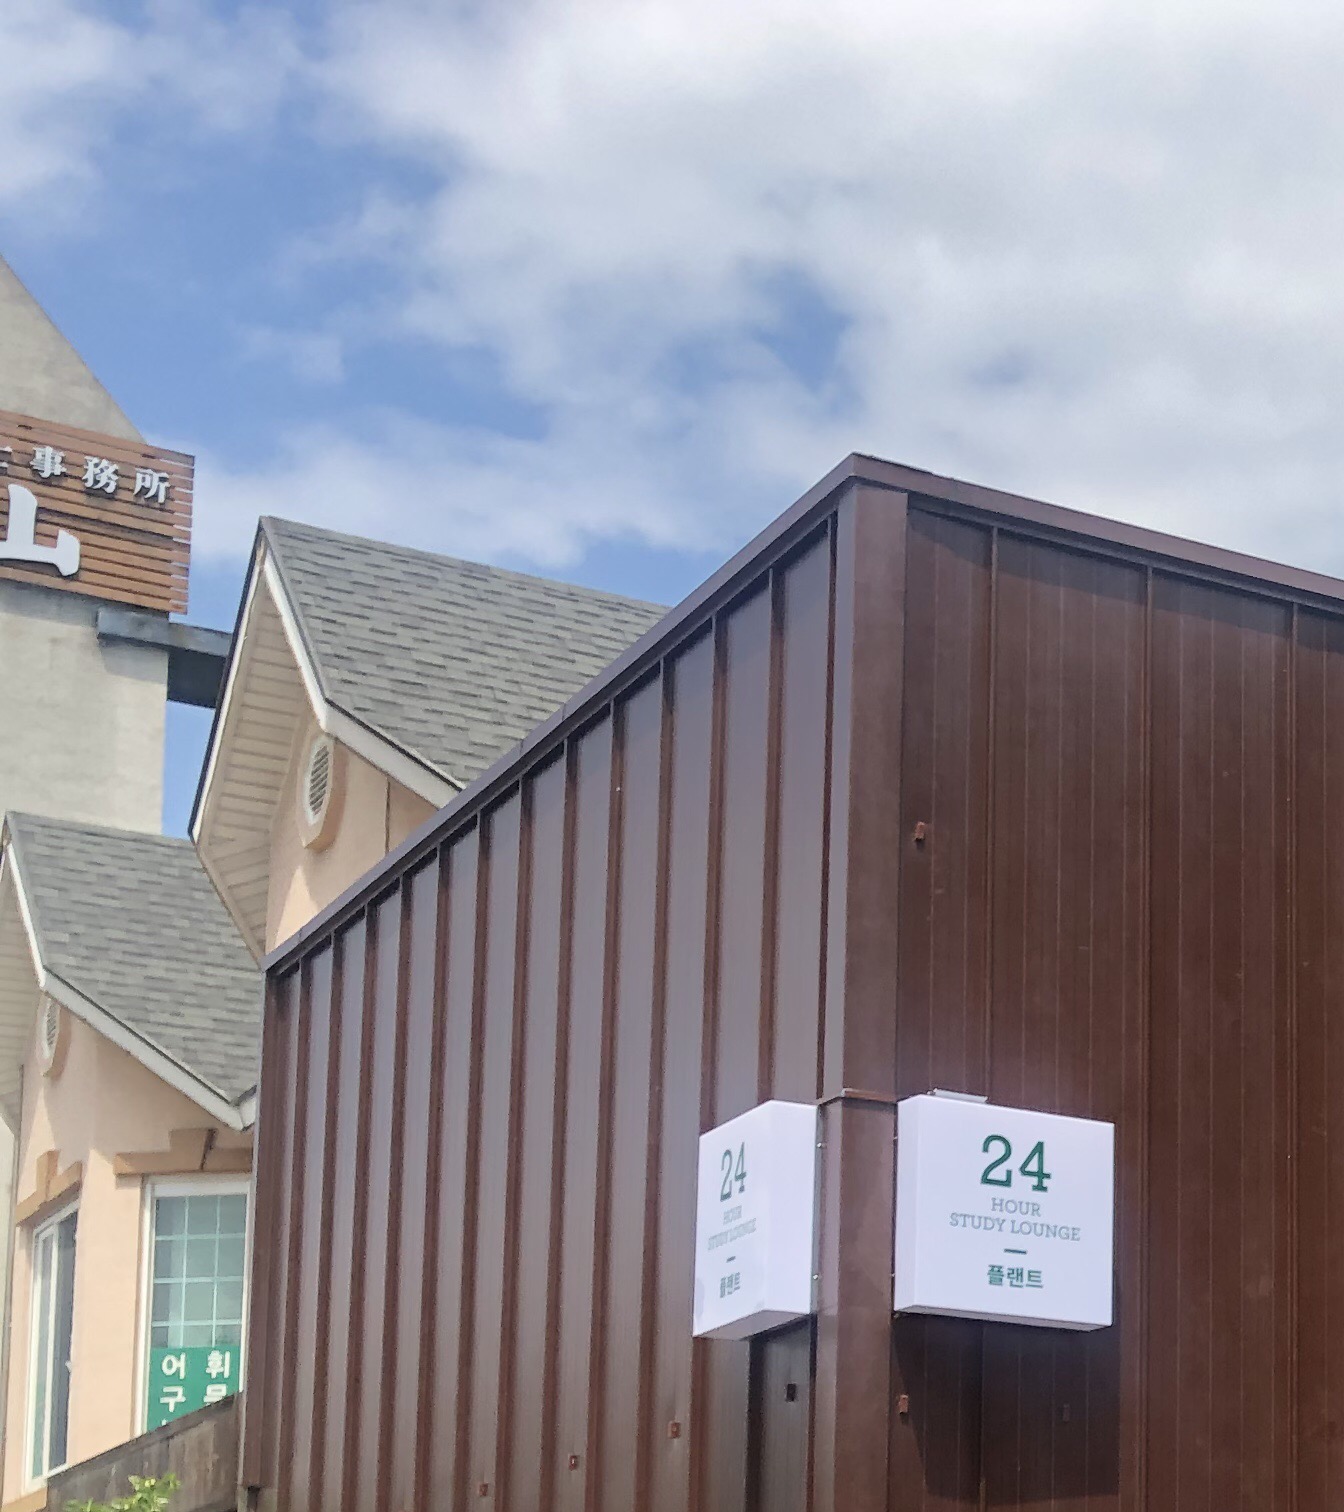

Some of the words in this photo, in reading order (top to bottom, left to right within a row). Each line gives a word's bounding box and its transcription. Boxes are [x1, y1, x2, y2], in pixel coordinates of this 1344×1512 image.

[0, 446, 170, 504] 事務所
[720, 1141, 747, 1202] 24
[980, 1134, 1052, 1193] 24
[949, 1212, 1006, 1233] STUDY
[1010, 1219, 1081, 1242] LOUNGE
[991, 1198, 1042, 1217] HOUR
[987, 1264, 1044, 1289] 플랜트
